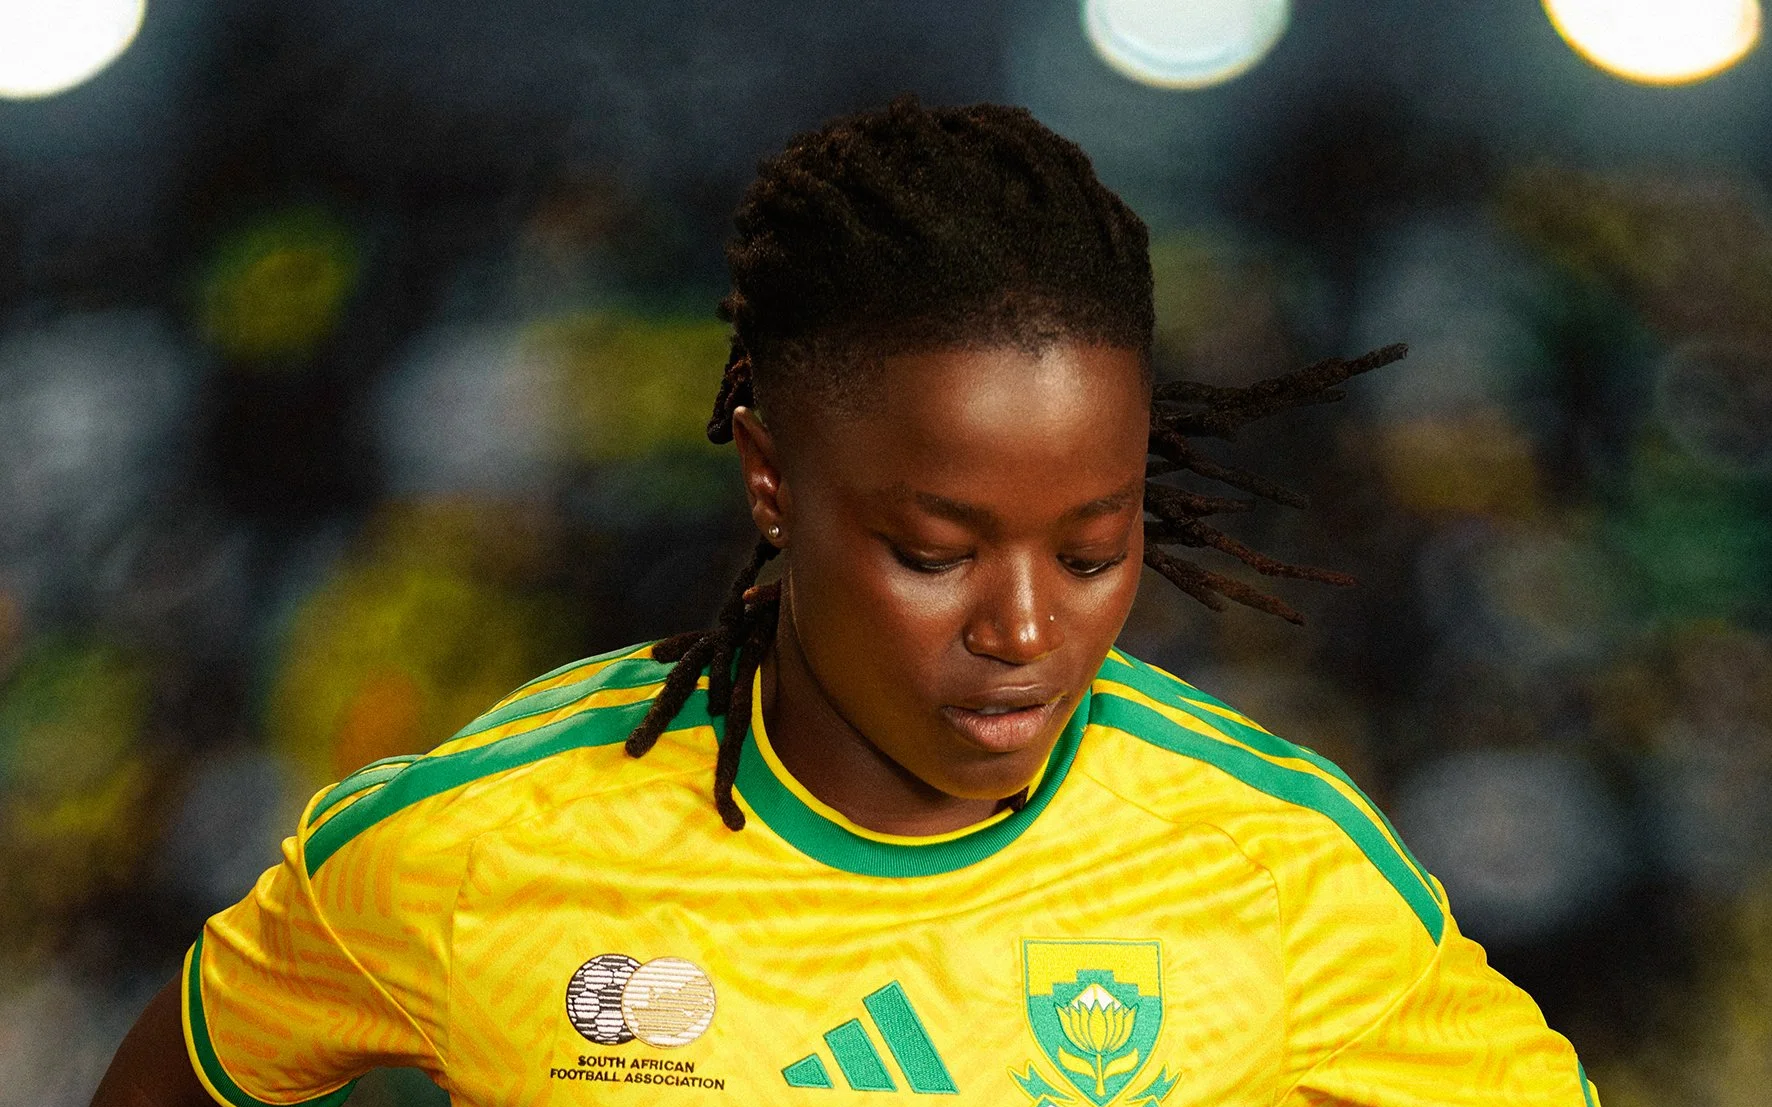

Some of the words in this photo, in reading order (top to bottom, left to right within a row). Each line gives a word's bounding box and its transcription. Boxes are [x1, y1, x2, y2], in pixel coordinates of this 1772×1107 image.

[578, 1055, 626, 1068] SOUTH
[630, 1058, 695, 1073] AFRICAN
[550, 1068, 620, 1082] FOOTBALL
[624, 1072, 725, 1090] ASSOCIATION
